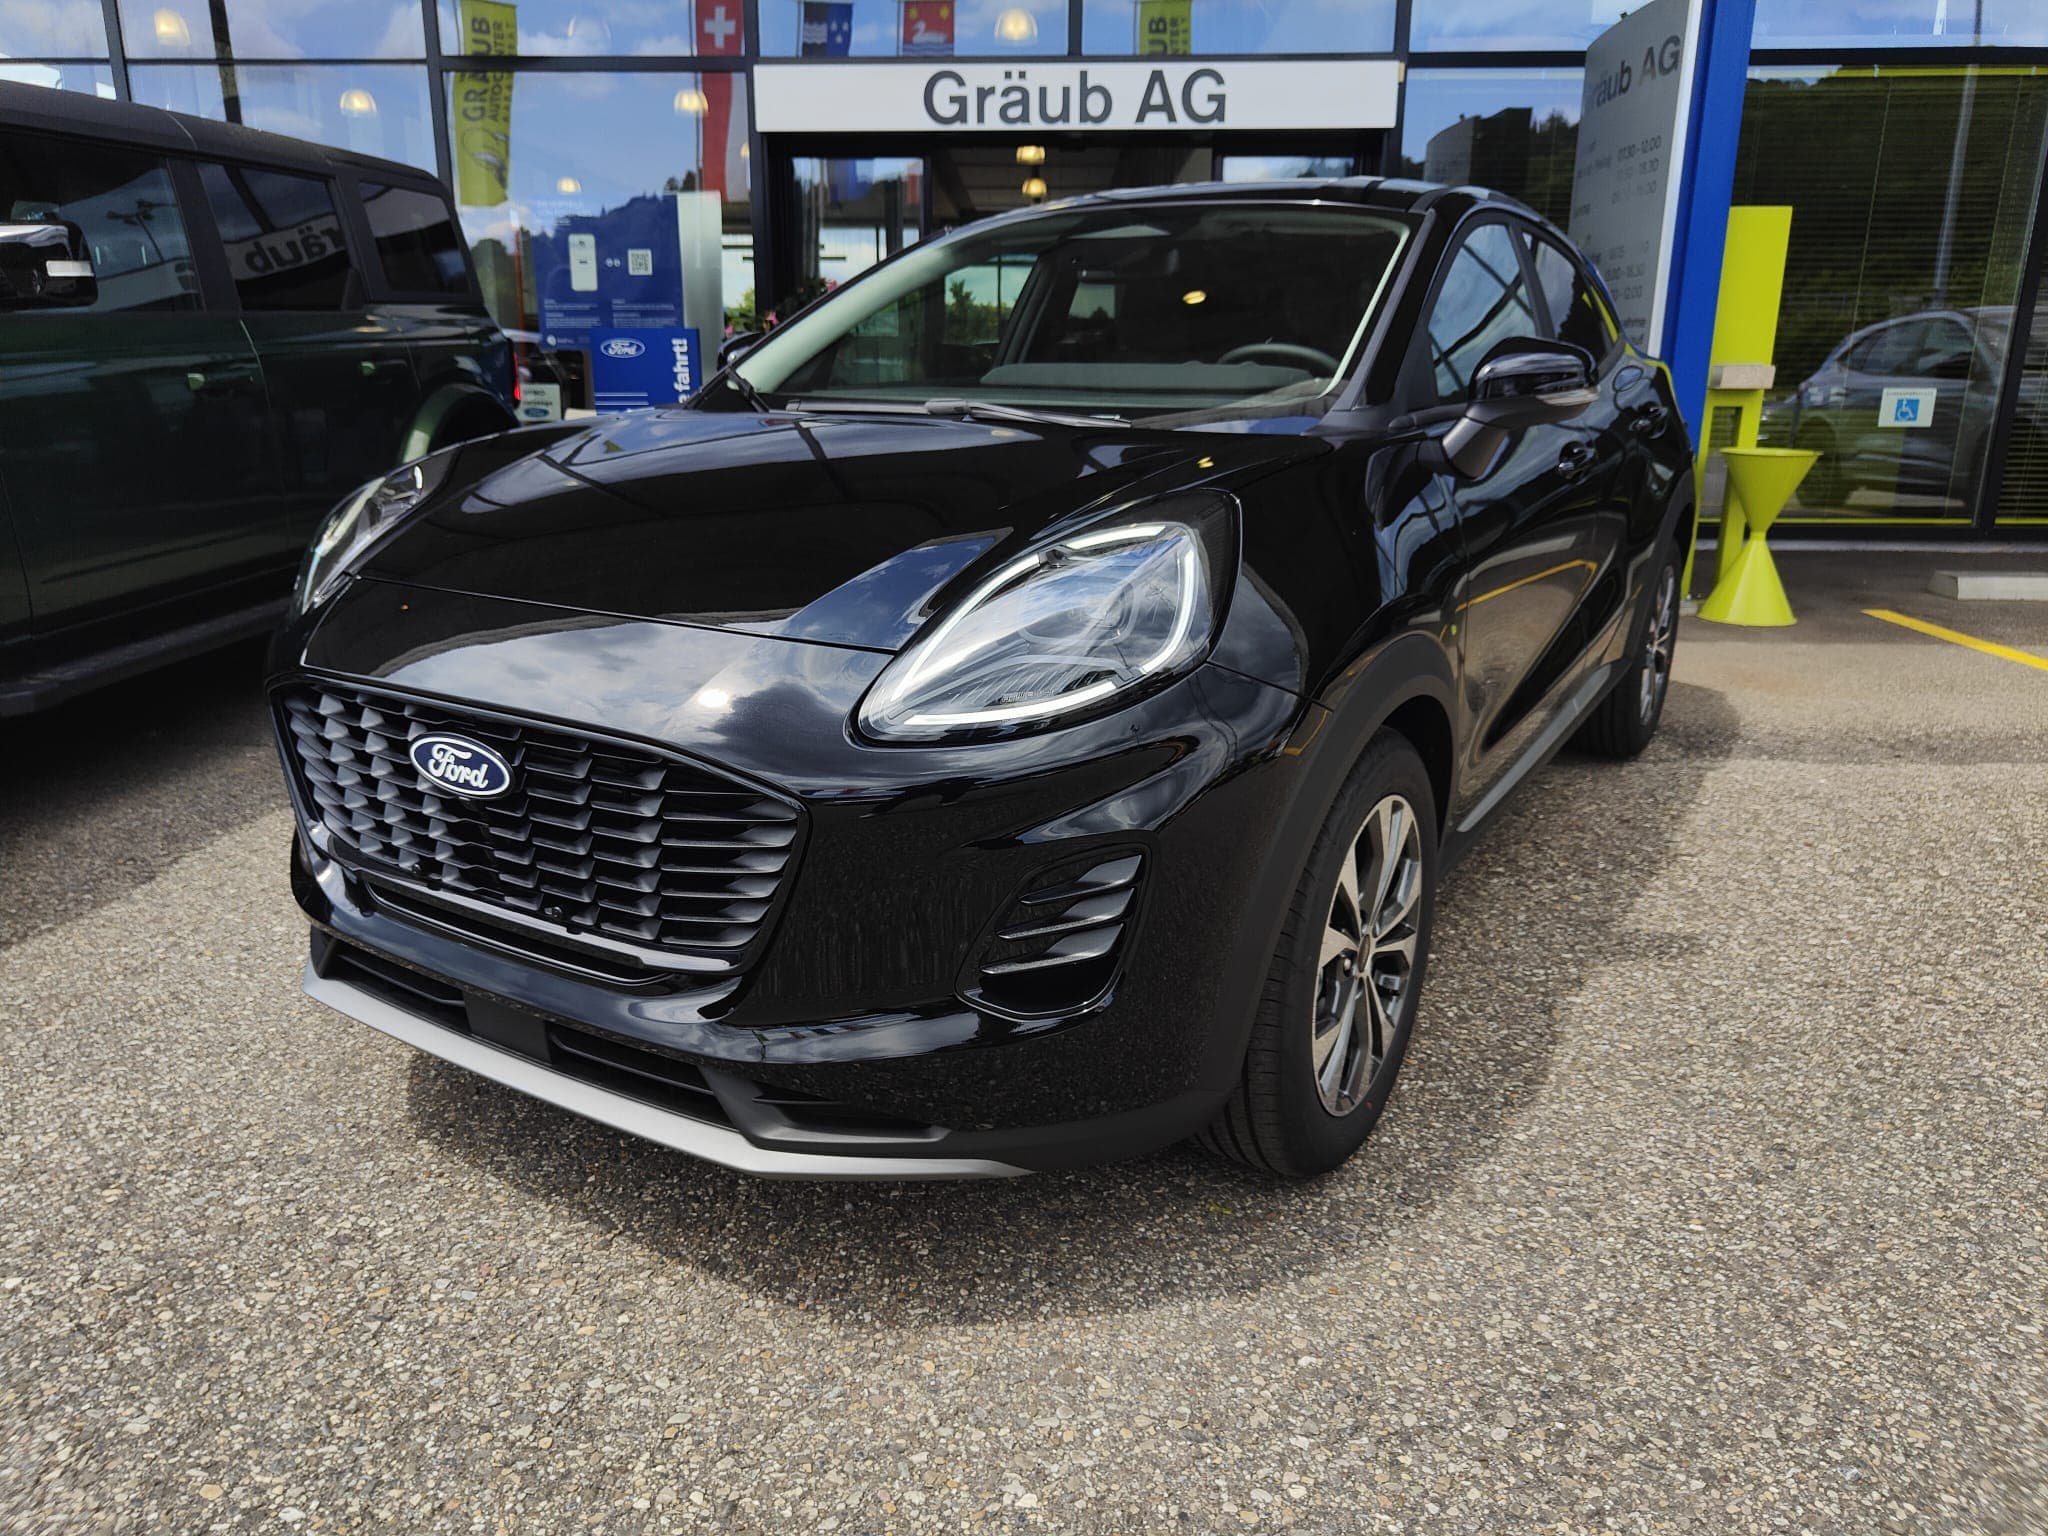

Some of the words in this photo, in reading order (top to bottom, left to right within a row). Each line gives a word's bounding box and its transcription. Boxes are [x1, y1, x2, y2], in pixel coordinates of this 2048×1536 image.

[487, 20, 505, 122] AUTOCNTER
[1639, 35, 1681, 86] AG
[923, 70, 1113, 125] Gräub
[1135, 68, 1227, 124] AG
